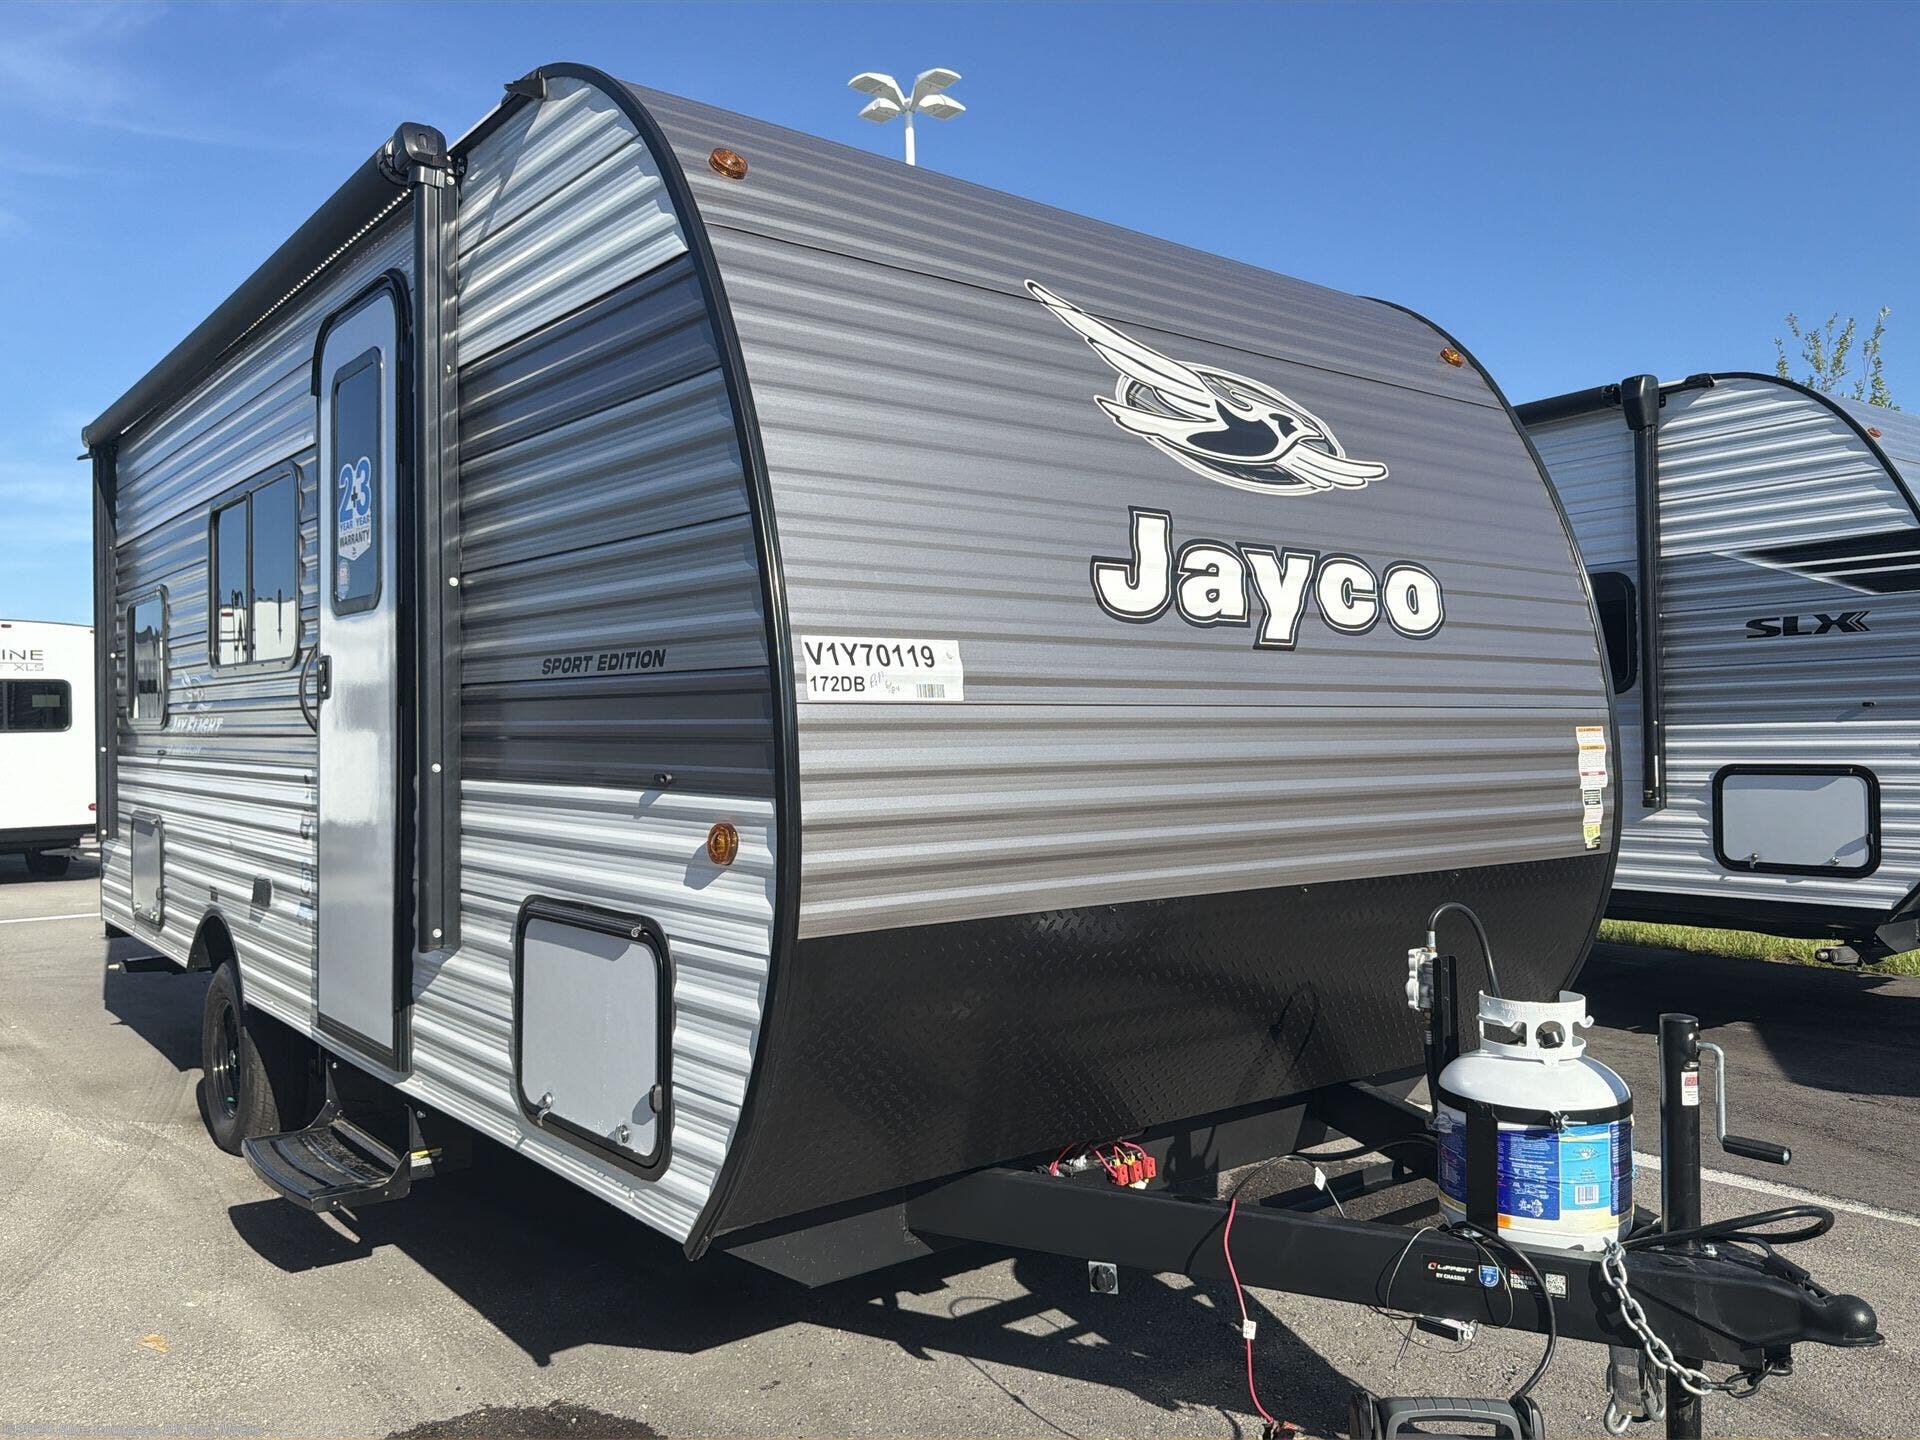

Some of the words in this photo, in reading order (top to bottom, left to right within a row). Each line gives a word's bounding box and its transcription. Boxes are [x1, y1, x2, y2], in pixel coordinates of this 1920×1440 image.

[339, 529, 370, 548] WARRANTY
[1091, 505, 1445, 651] Jayco
[1746, 611, 1871, 638] SLX
[542, 655, 593, 675] SPORT
[597, 649, 666, 672] EDITION
[805, 642, 935, 668] V1Y70119
[810, 675, 866, 692] 172DB
